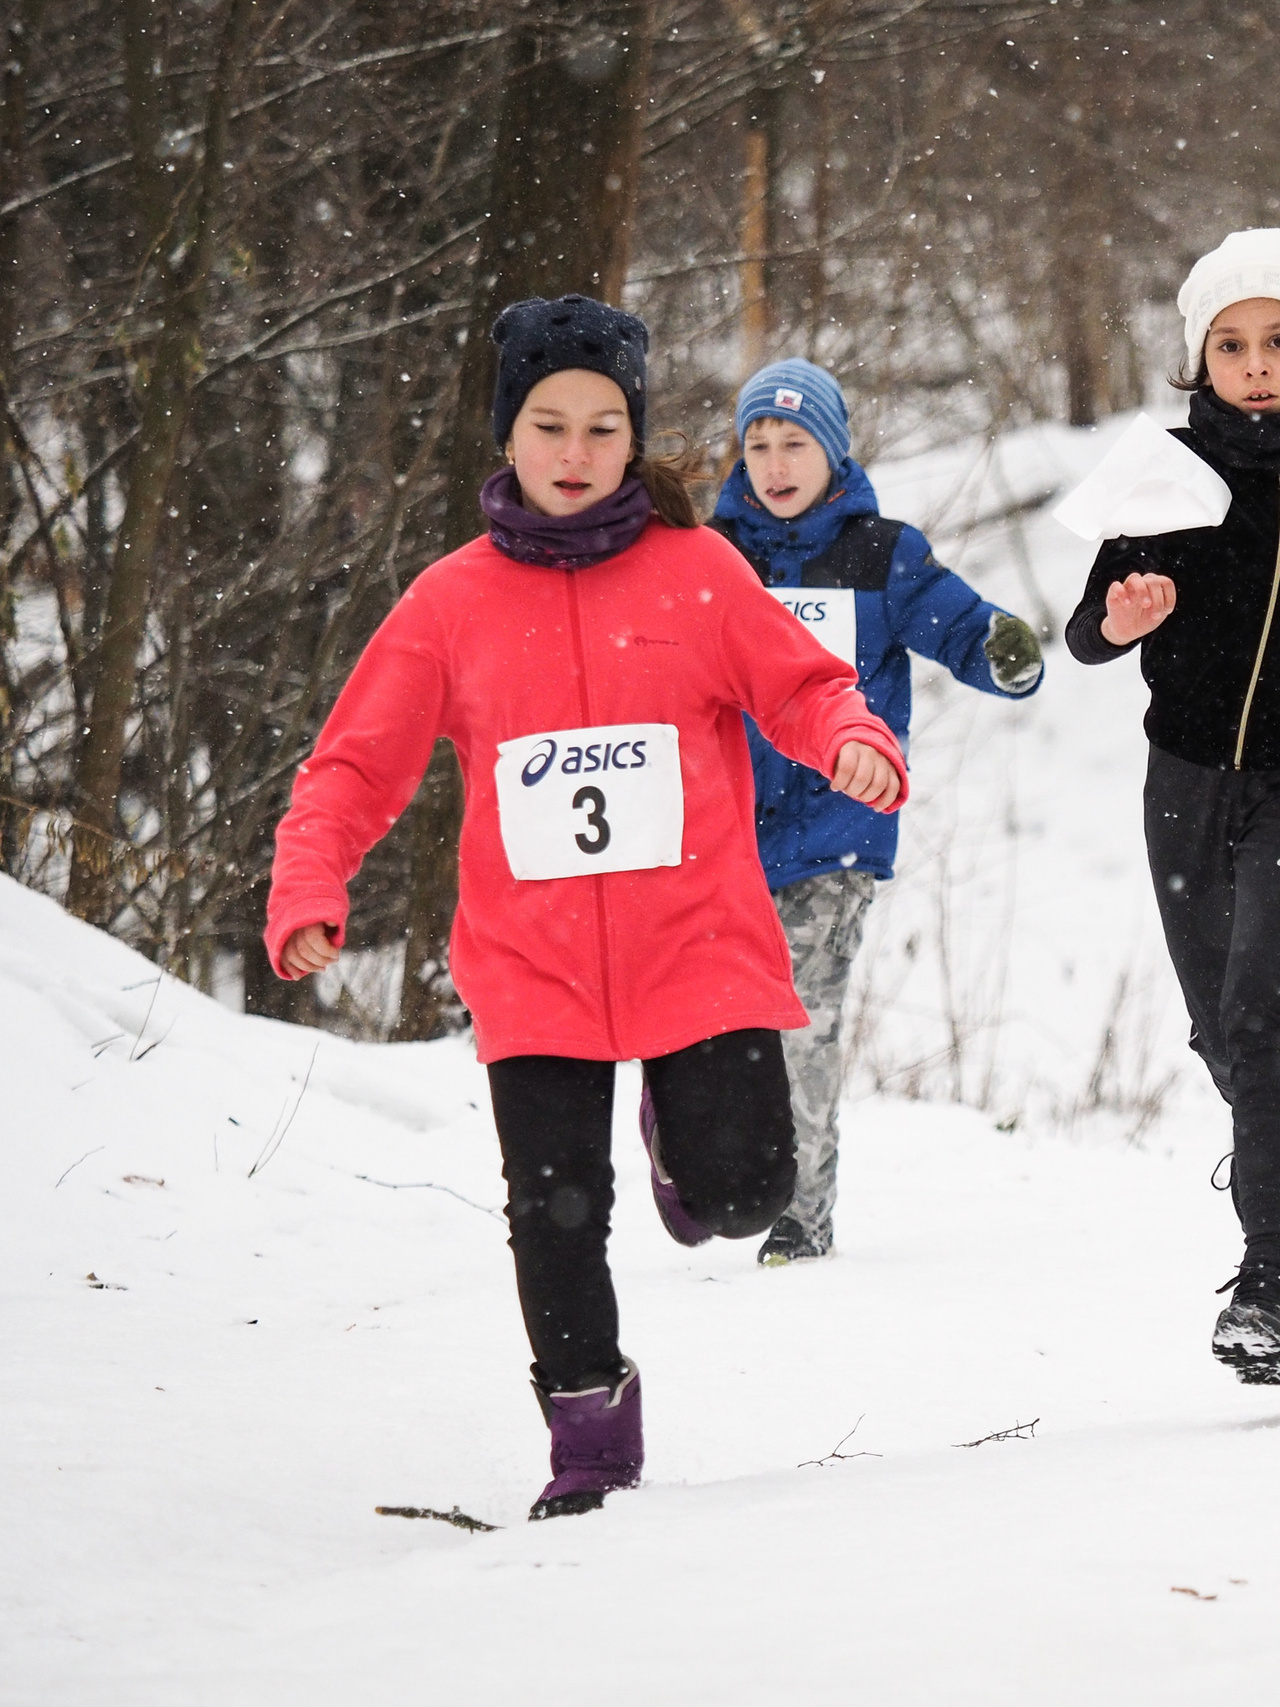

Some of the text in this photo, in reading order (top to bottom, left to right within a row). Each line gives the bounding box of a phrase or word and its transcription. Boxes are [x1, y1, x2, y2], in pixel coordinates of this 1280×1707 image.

[782, 601, 827, 621] ICS
[561, 740, 647, 775] asics
[572, 785, 612, 856] 3
